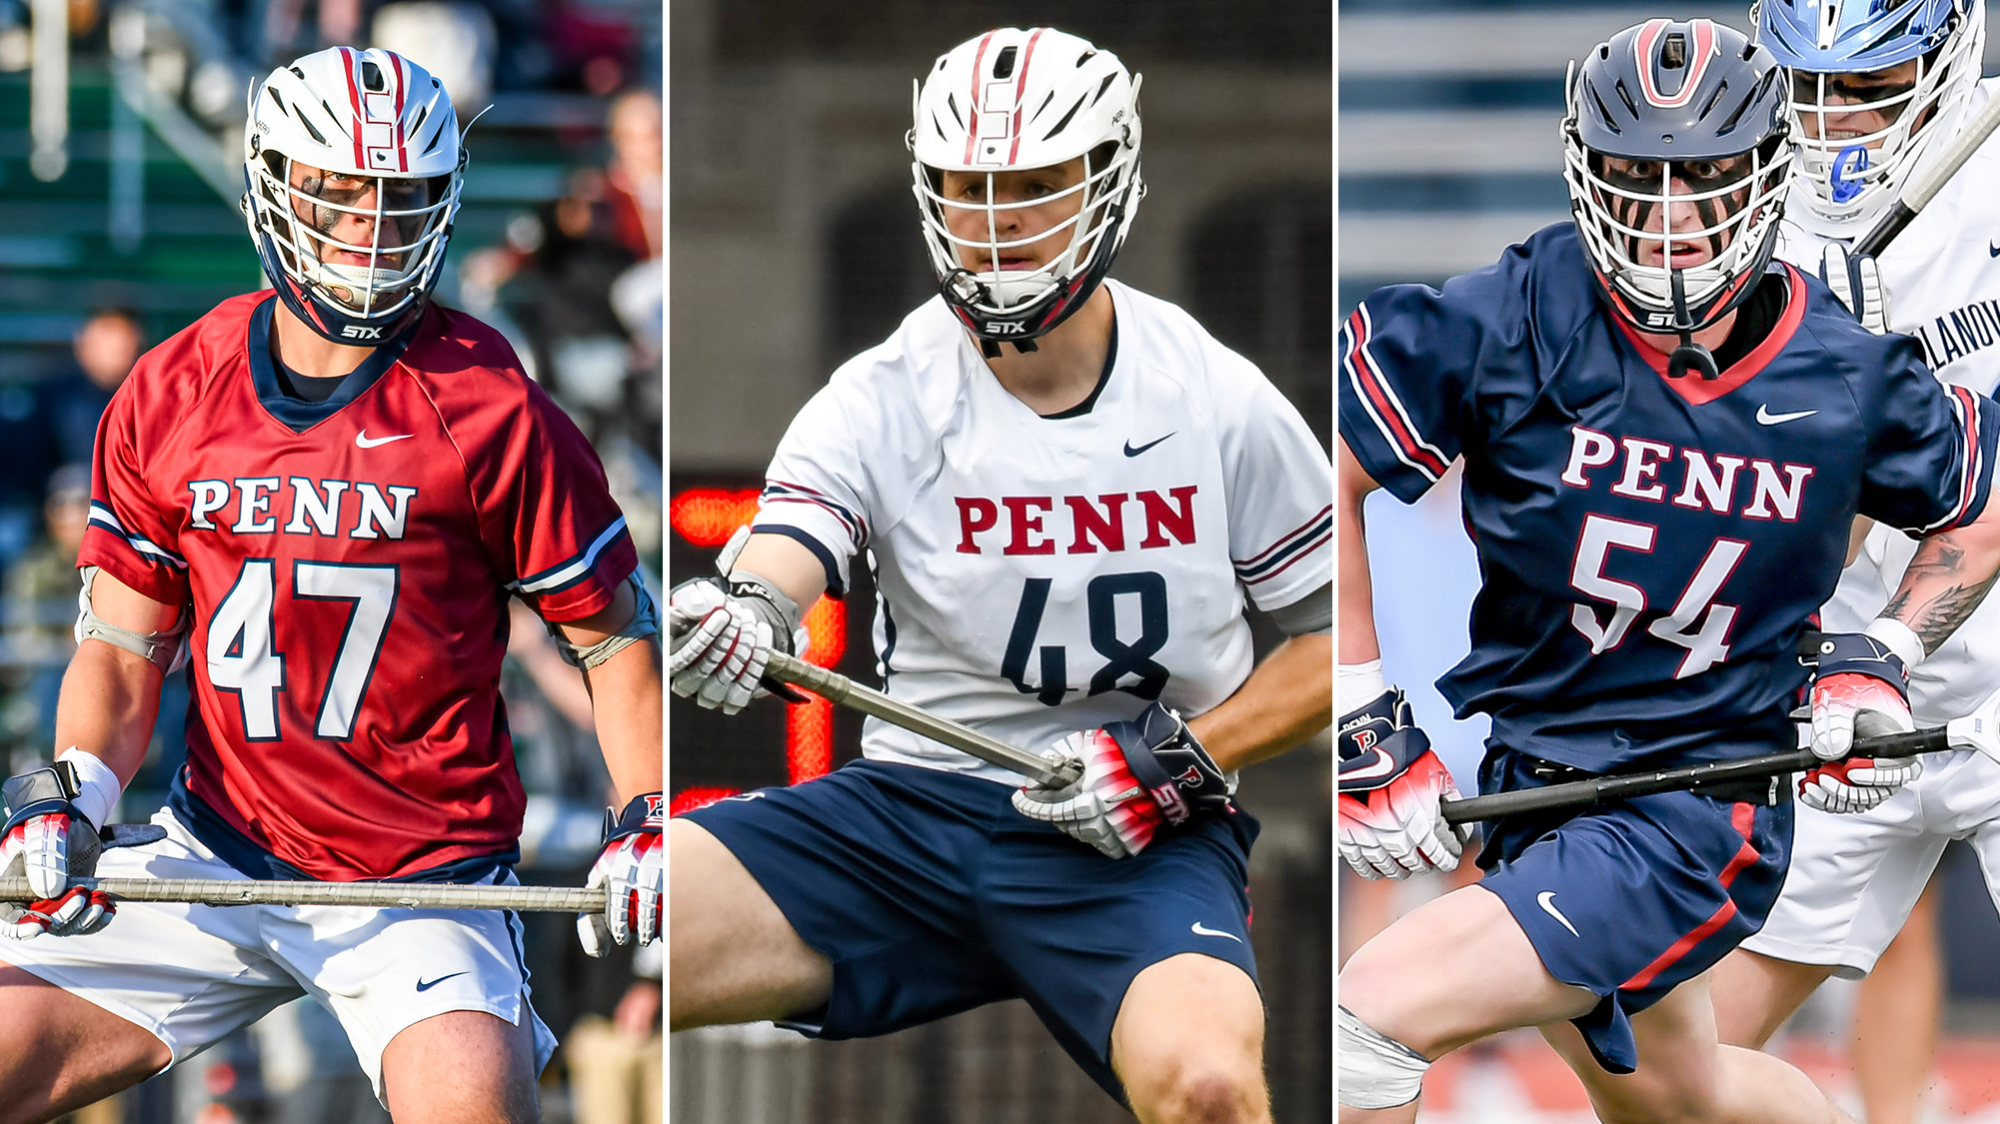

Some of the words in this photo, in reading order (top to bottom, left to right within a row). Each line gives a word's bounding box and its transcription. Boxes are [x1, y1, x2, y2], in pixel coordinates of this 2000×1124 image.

[341, 325, 383, 339] STX
[985, 321, 1026, 334] STX
[1646, 313, 1676, 326] ST
[1909, 299, 2000, 374] LANOV
[187, 476, 418, 541] PENN
[1561, 425, 1816, 523] PENN
[953, 485, 1198, 556] PENN
[1569, 512, 1751, 681] 54
[206, 557, 400, 743] 47
[1000, 571, 1171, 707] 48
